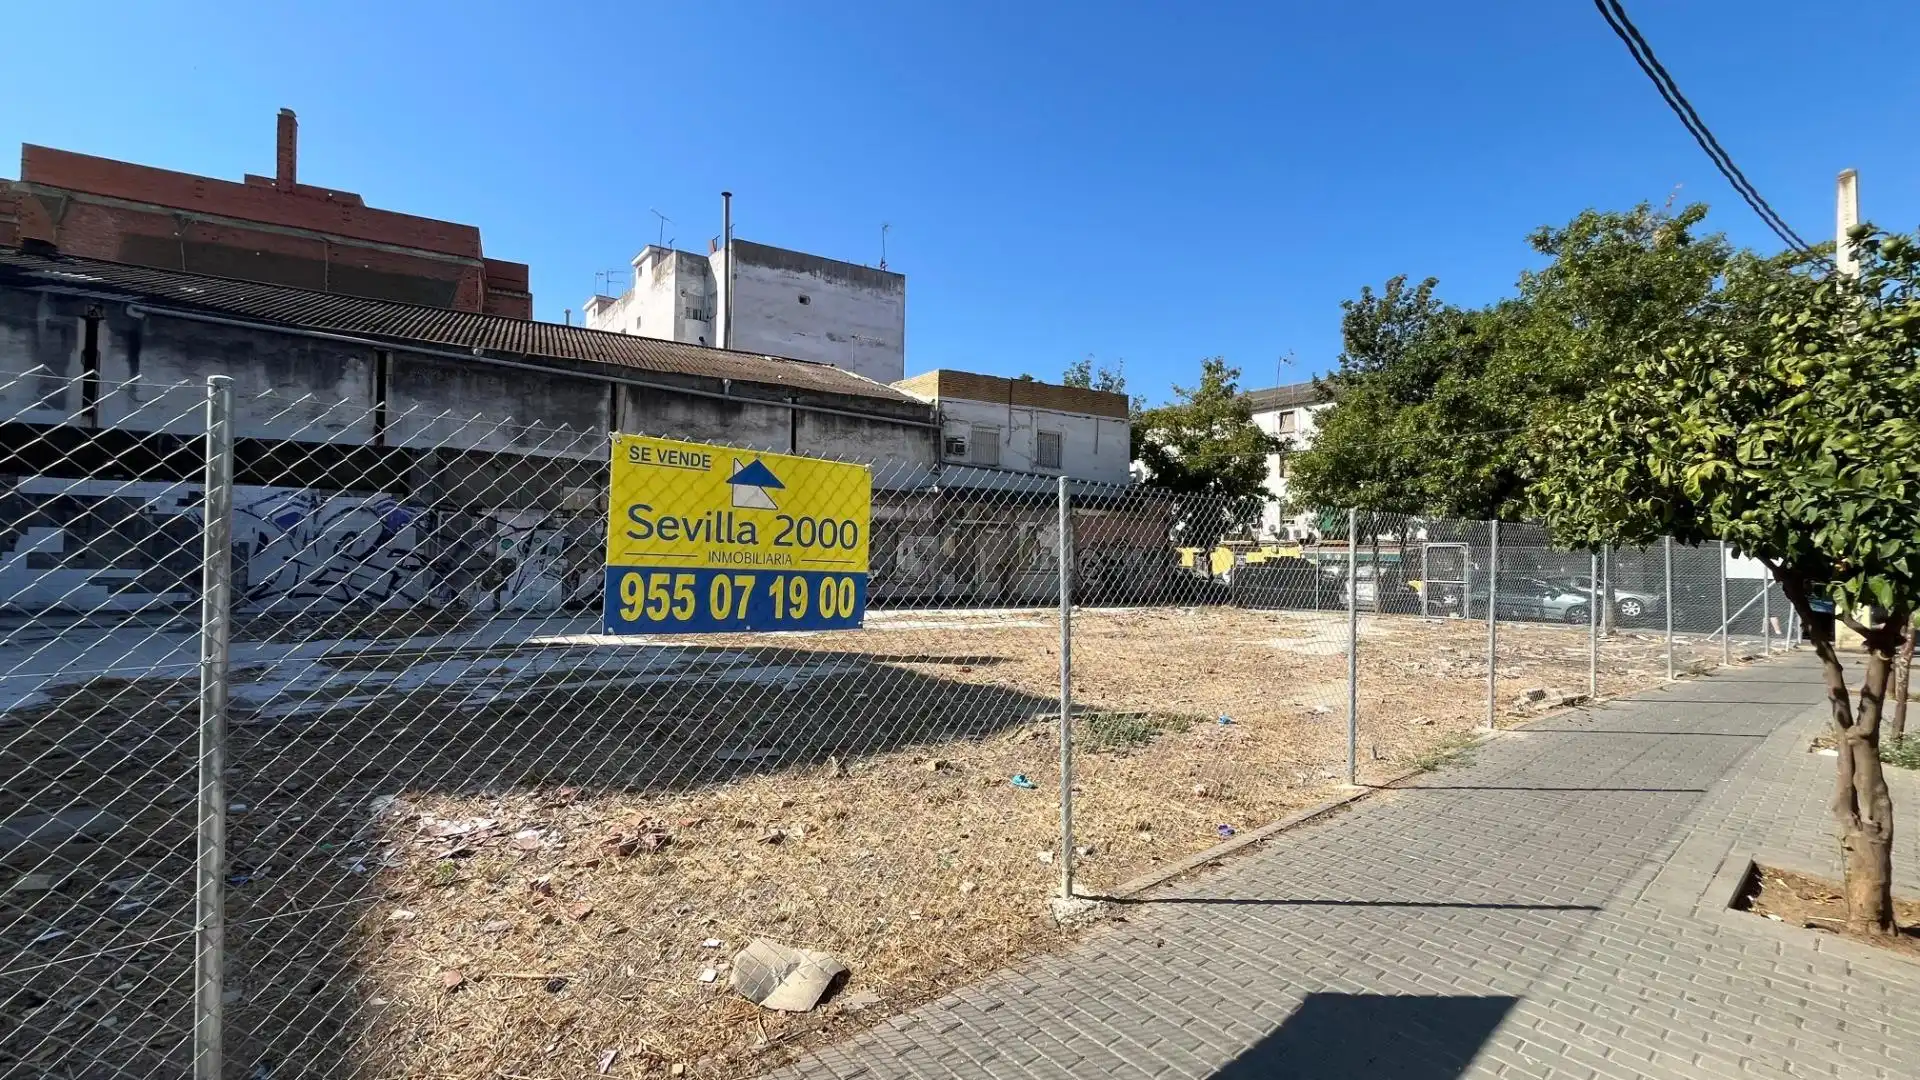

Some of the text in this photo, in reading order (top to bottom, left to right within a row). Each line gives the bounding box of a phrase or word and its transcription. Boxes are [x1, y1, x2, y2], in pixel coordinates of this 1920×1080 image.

[629, 445, 711, 468] SE VENDE
[626, 504, 858, 550] Sevilla 2000
[708, 551, 793, 566] INMOBILIARIA
[619, 572, 856, 622] 955 07 19 00
